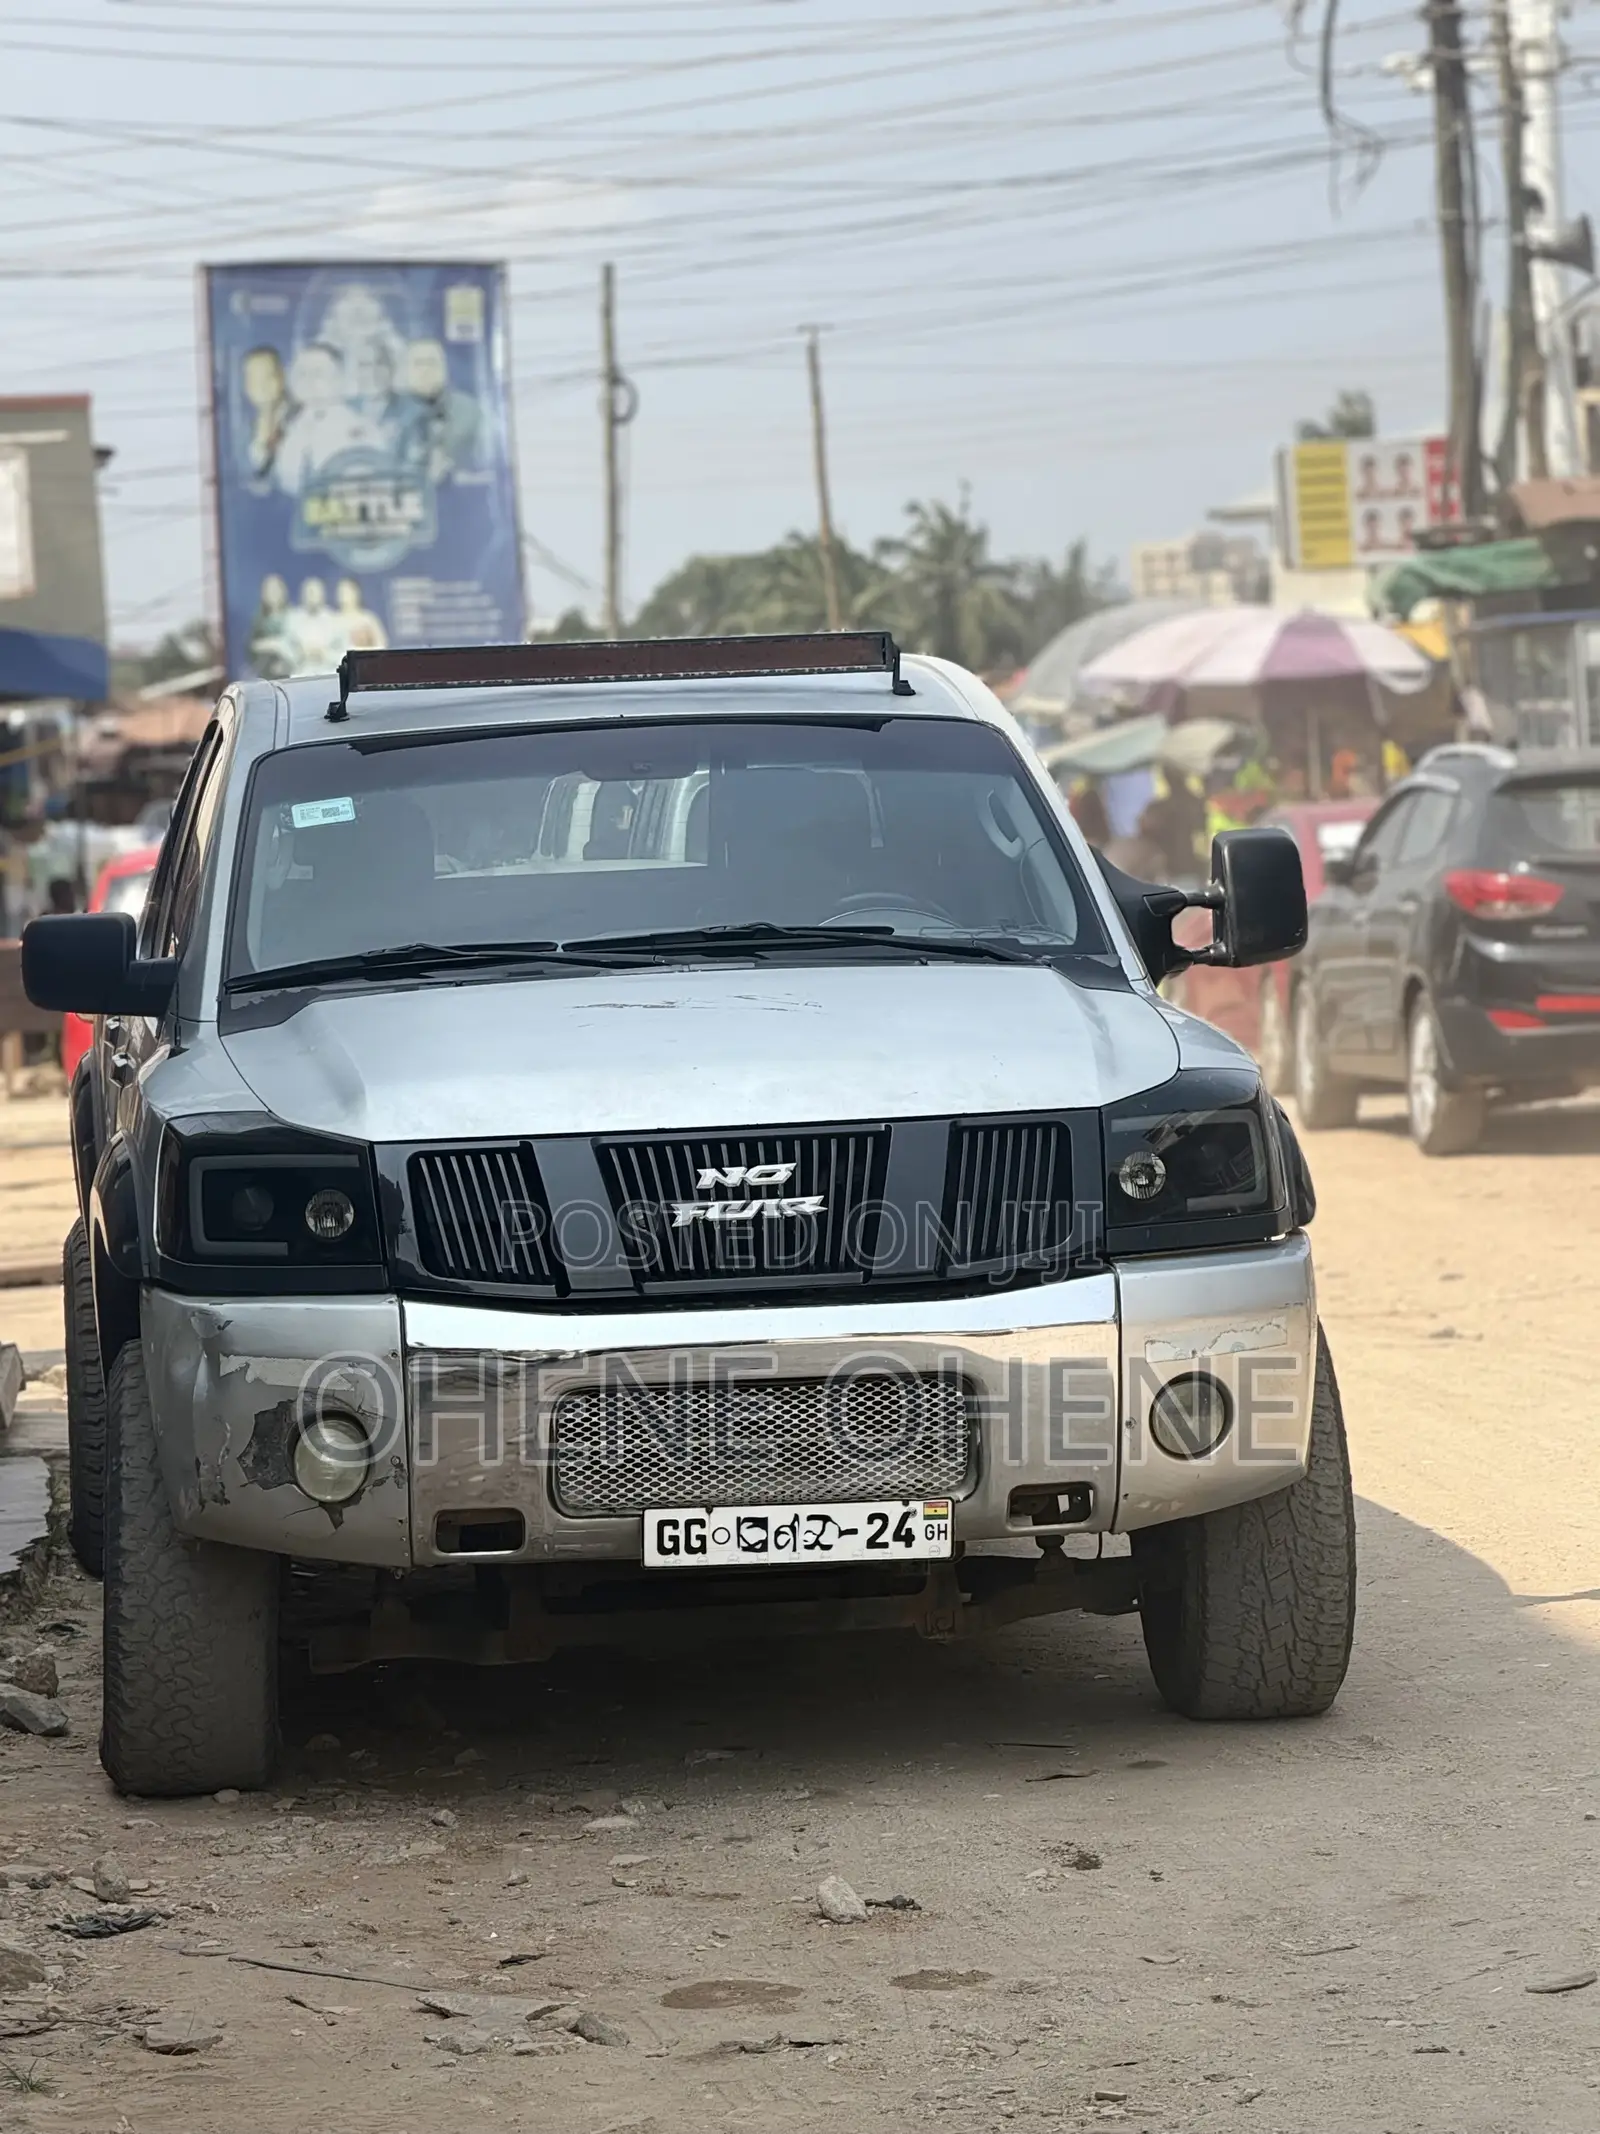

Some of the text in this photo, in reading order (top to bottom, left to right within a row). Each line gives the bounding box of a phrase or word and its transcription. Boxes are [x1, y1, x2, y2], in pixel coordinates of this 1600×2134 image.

[696, 1162, 797, 1189] NO
[656, 1518, 707, 1556] GG
[924, 1523, 948, 1541] GH
